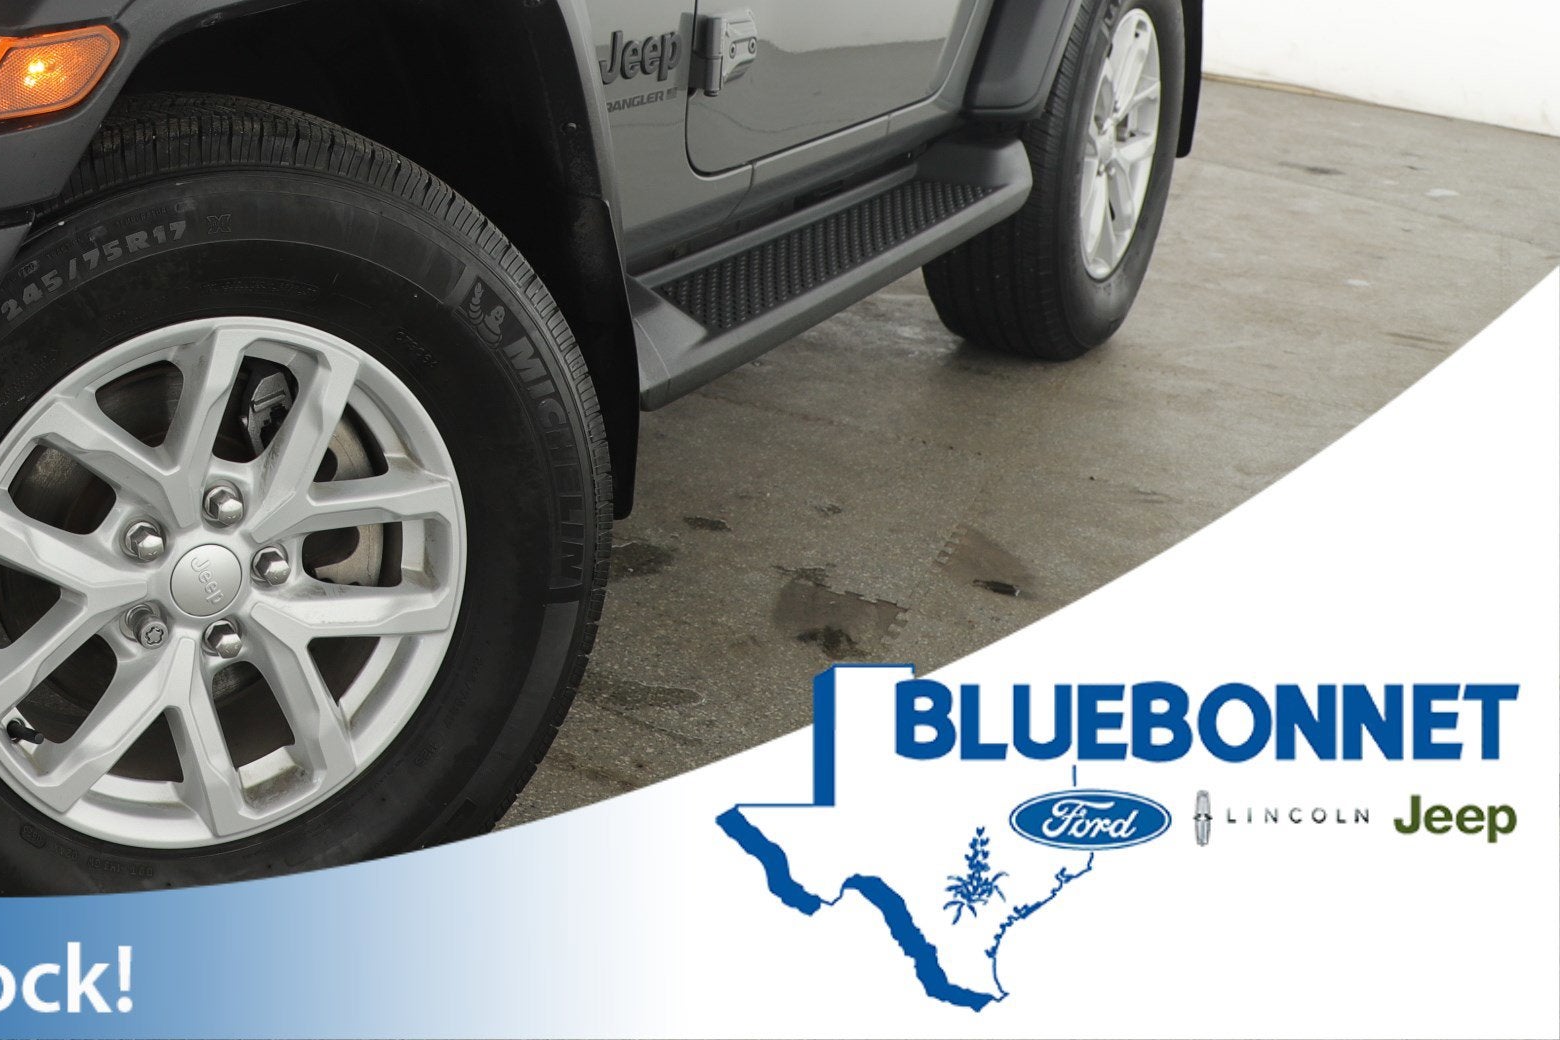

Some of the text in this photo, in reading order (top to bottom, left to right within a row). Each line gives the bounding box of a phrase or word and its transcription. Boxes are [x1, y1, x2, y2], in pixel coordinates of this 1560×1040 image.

[599, 30, 683, 85] Jeep
[606, 90, 665, 114] RANGLER
[0, 220, 187, 322] 245/75R17
[190, 557, 225, 605] Jeep
